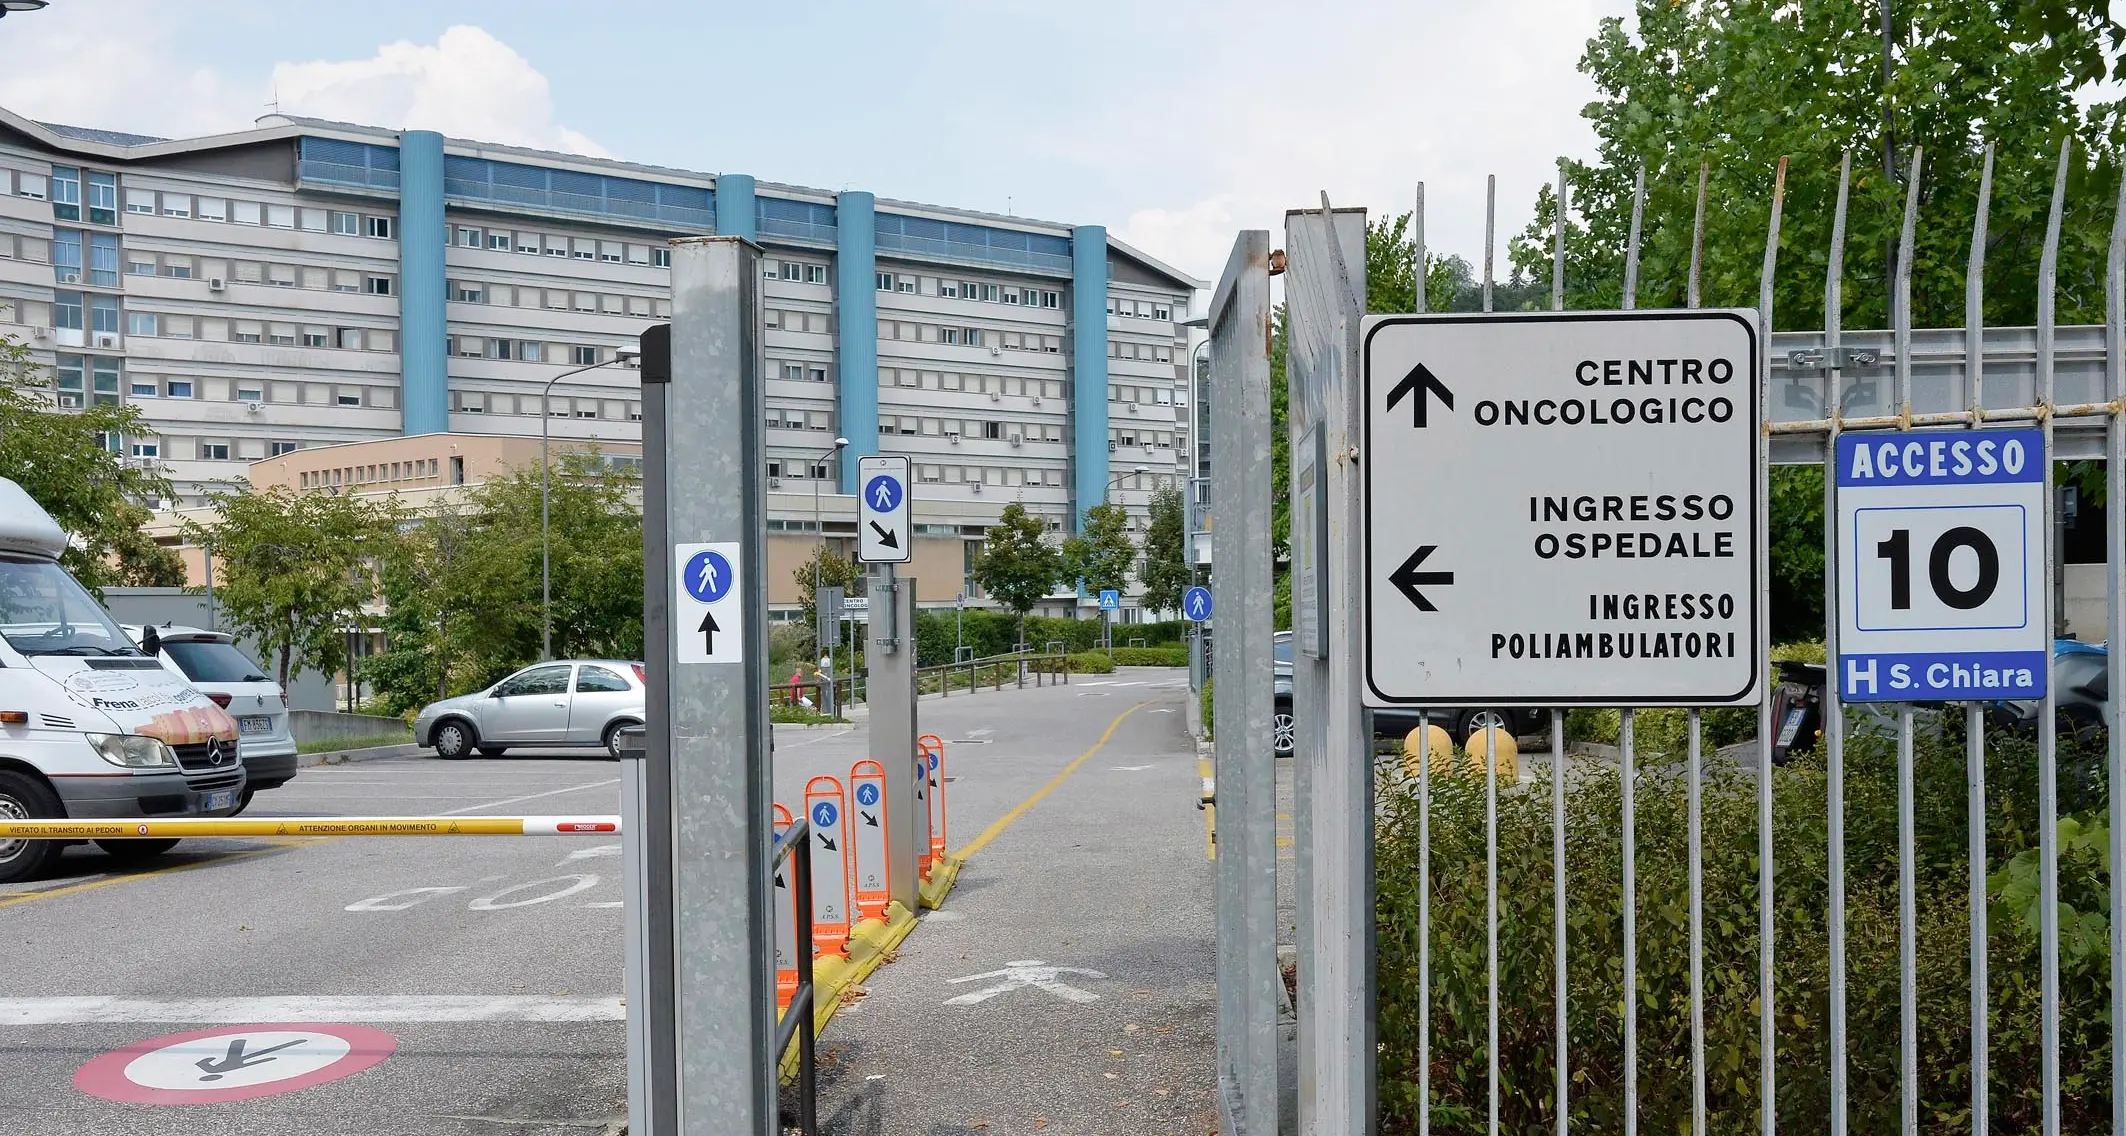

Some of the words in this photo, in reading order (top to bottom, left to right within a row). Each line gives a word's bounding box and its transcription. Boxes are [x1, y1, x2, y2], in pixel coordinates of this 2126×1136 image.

[1575, 358, 1734, 387] CENTRO
[1474, 396, 1734, 427] ONCOLOGICO
[1851, 439, 2025, 479] ACCESSO
[1530, 494, 1734, 522] INGRESSO
[1534, 531, 1734, 560] OSPEDALE
[1877, 526, 2000, 610] 10
[1590, 593, 1735, 620] INGRESSO
[1491, 631, 1735, 660] POLIAMBULATORI
[1847, 658, 1878, 695] H
[1888, 663, 1920, 689] S.
[1926, 662, 2033, 689] Chiara
[93, 697, 139, 709] Frena
[9, 826, 39, 834] VIETATO
[41, 826, 48, 834] IL
[49, 826, 84, 834] TRANSITO
[86, 825, 94, 833] AI
[96, 825, 123, 833] PEDONI
[299, 824, 346, 832] ATTENZIONE
[348, 824, 378, 832] ORGANI
[390, 823, 437, 831] MOVIMENTO
